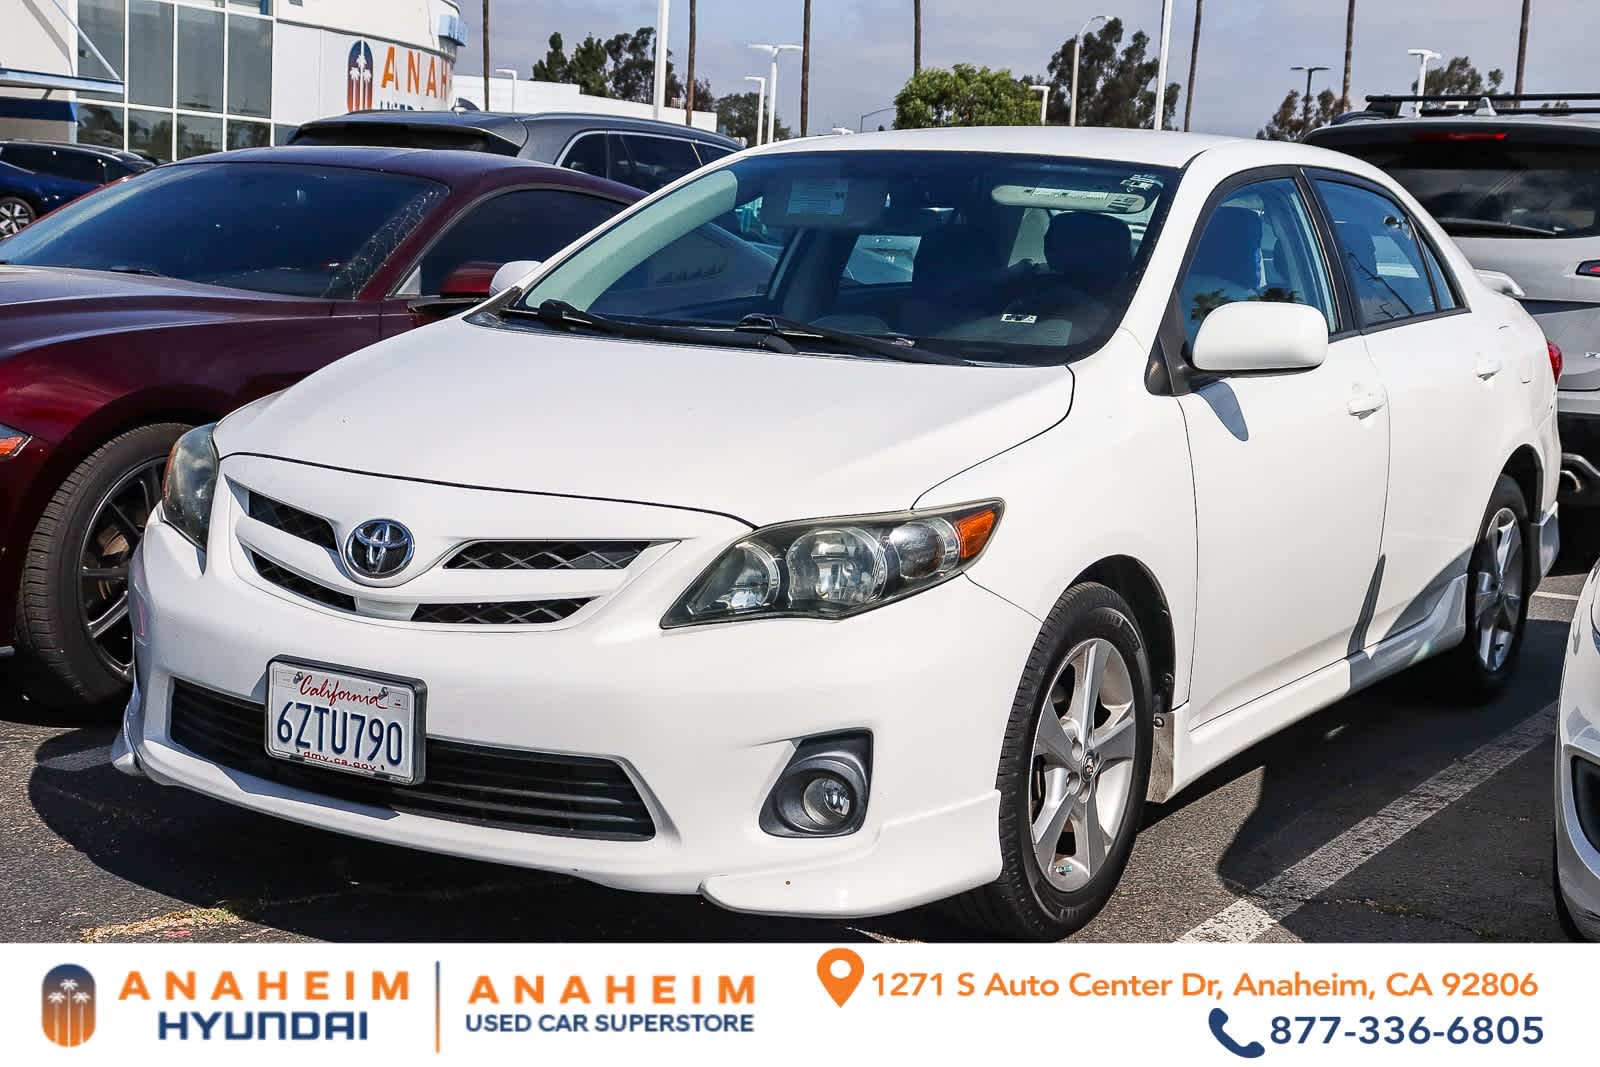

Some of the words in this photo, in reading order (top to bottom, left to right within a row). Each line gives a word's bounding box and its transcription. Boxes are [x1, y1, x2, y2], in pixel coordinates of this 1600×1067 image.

[301, 674, 388, 709] California
[277, 701, 403, 766] 6ZTU790
[303, 750, 377, 771] dmv.ca.gov
